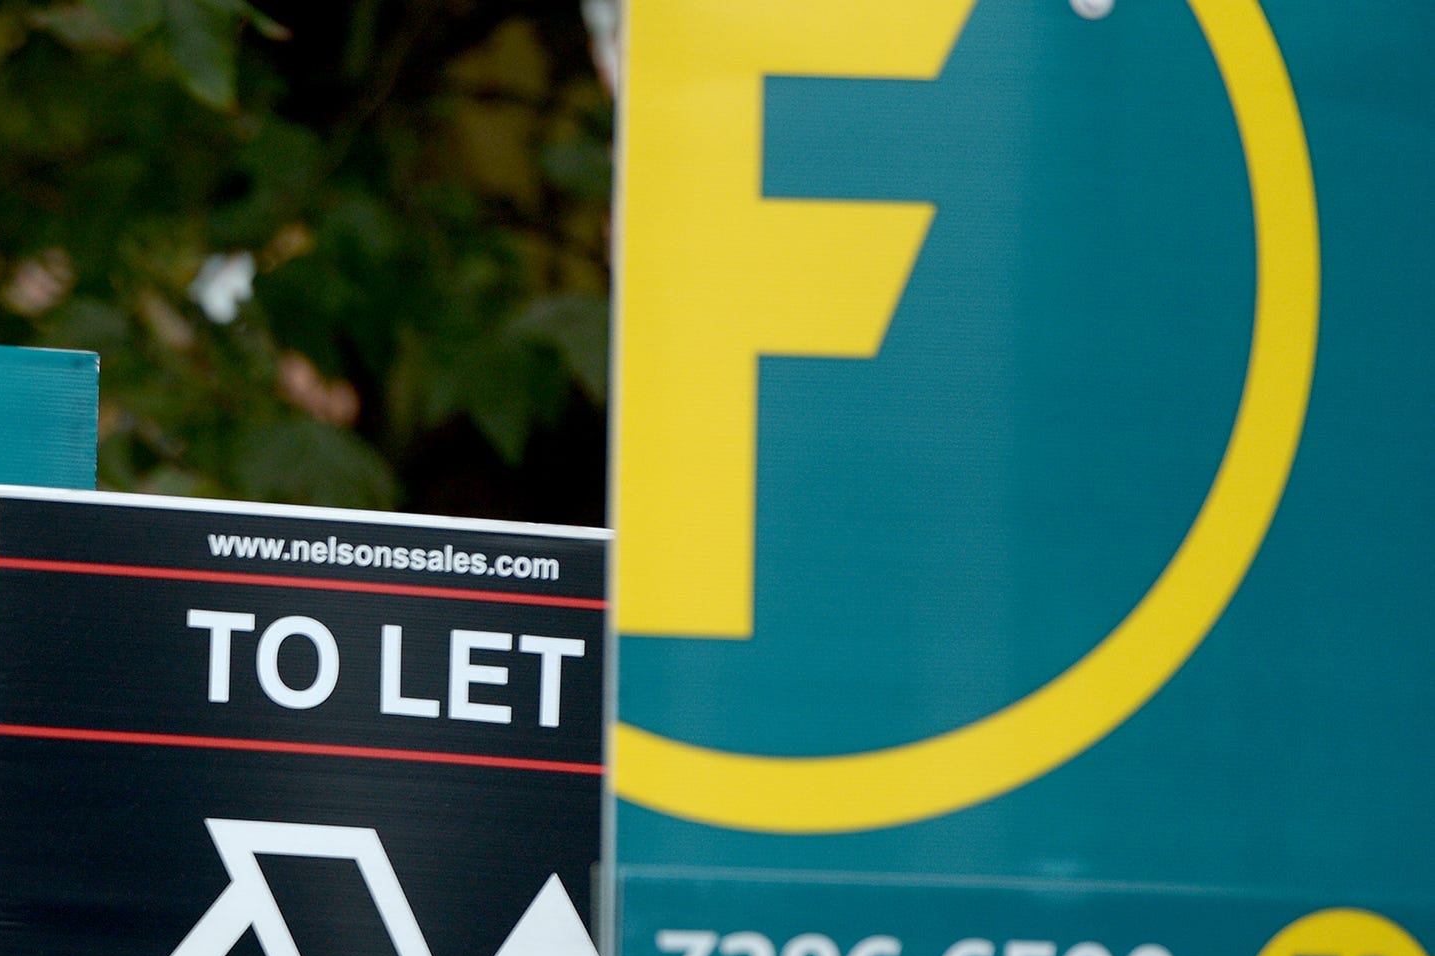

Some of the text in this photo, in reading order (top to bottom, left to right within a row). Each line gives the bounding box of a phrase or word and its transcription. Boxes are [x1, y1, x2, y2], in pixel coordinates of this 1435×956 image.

[208, 532, 560, 581] www.nelsonssales.com
[187, 608, 585, 728] TO LET
